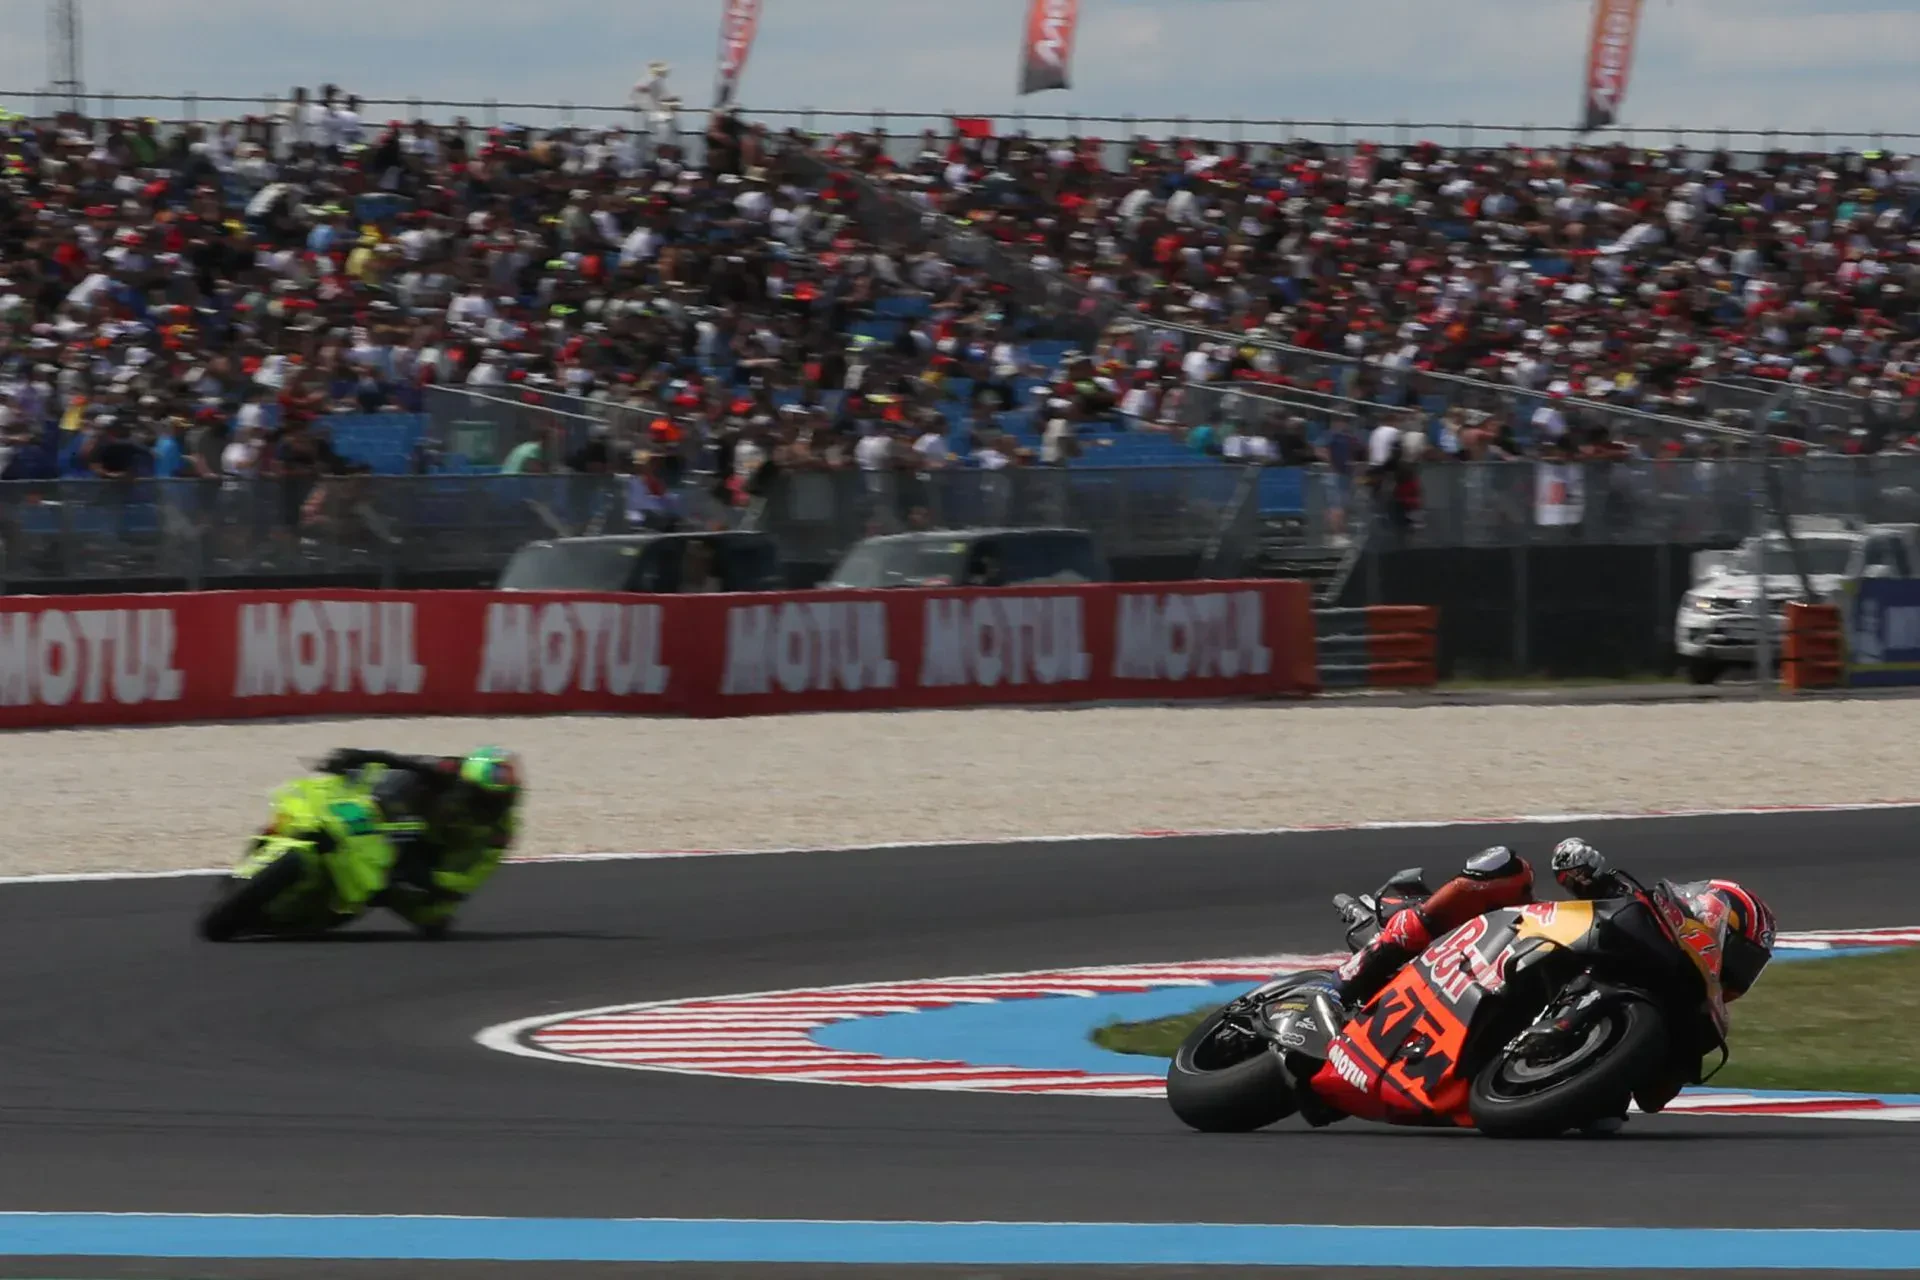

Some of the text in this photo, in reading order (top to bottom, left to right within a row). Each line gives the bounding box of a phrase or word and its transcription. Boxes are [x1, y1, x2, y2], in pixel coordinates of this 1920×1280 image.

[234, 600, 425, 698] MOTUL
[477, 602, 669, 695] MOTUL
[722, 601, 897, 694] MOTUL
[919, 596, 1092, 687] MOTUL
[1112, 591, 1272, 681] MOTUL
[1328, 1043, 1369, 1094] MOTUL
